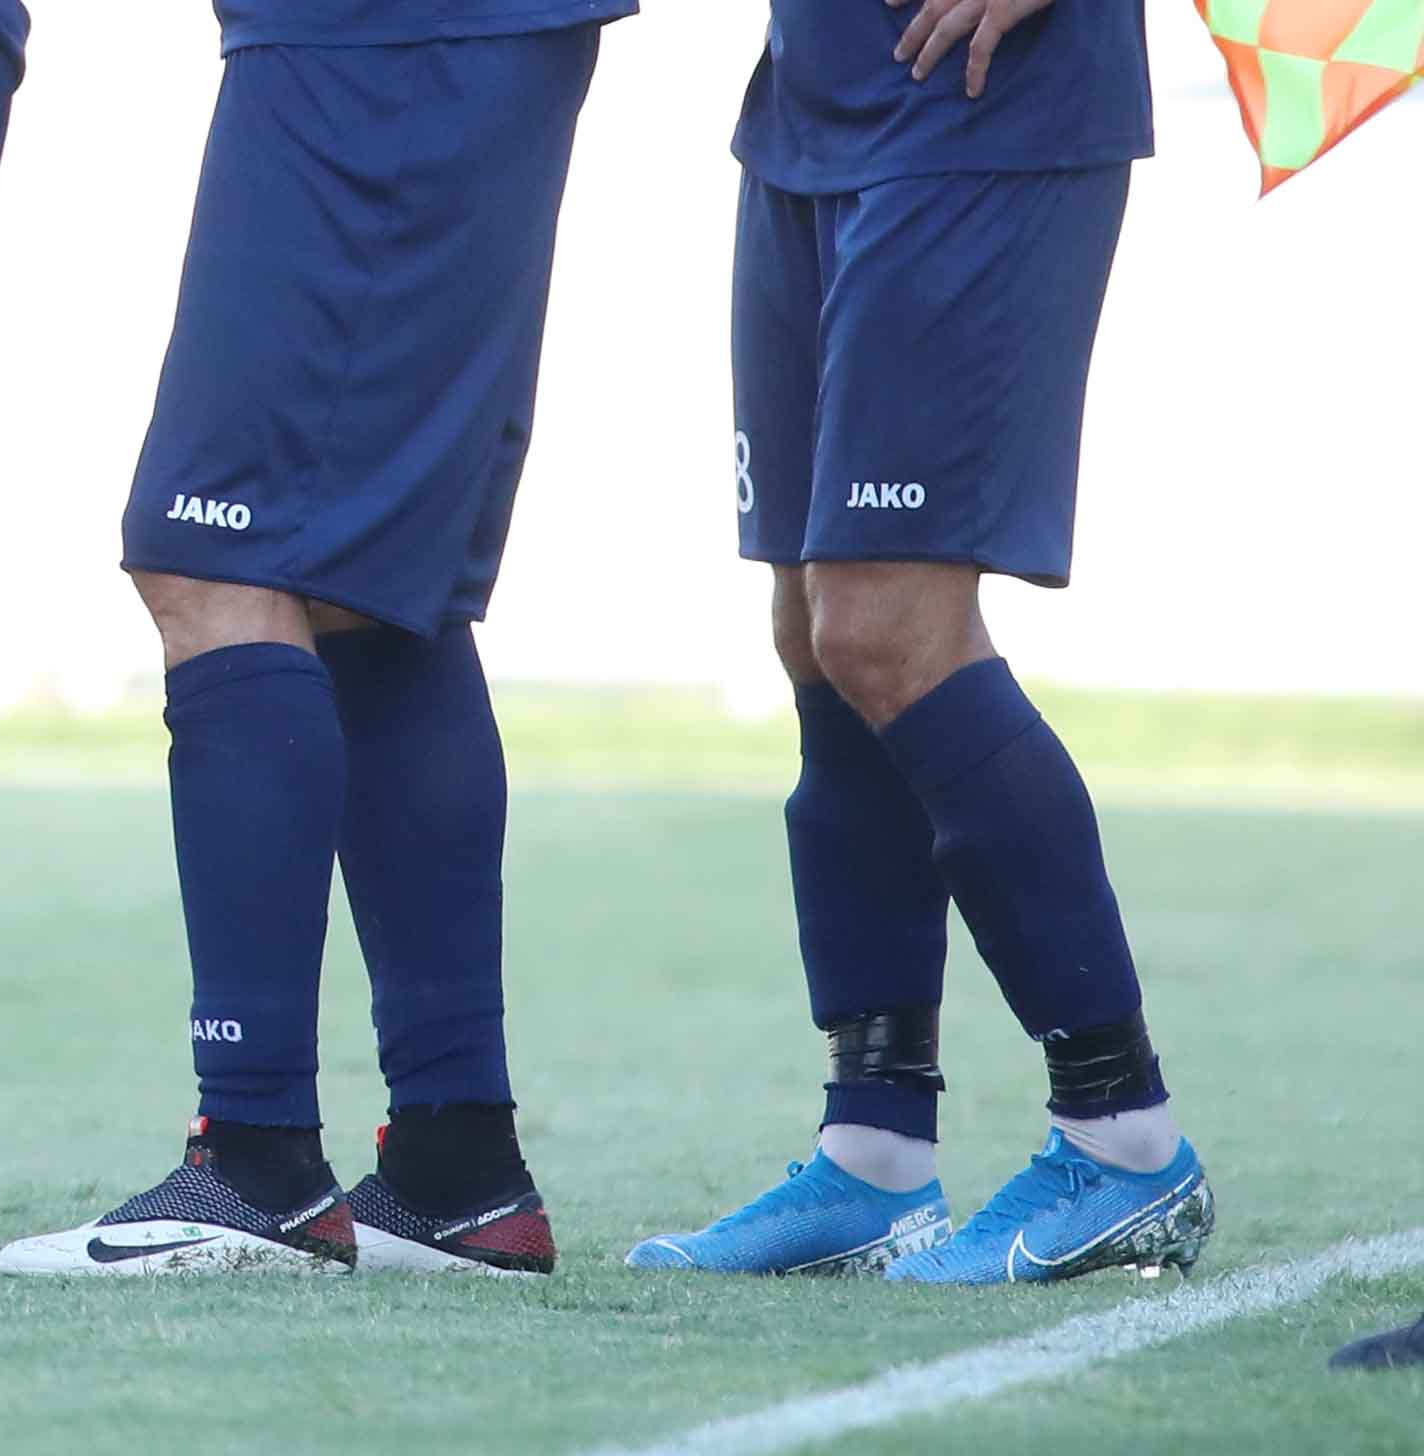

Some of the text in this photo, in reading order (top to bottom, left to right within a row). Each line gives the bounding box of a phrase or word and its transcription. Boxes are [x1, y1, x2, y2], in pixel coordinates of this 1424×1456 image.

[846, 482, 926, 509] JAKO
[166, 493, 252, 531] JAKO
[192, 1019, 243, 1042] AKO
